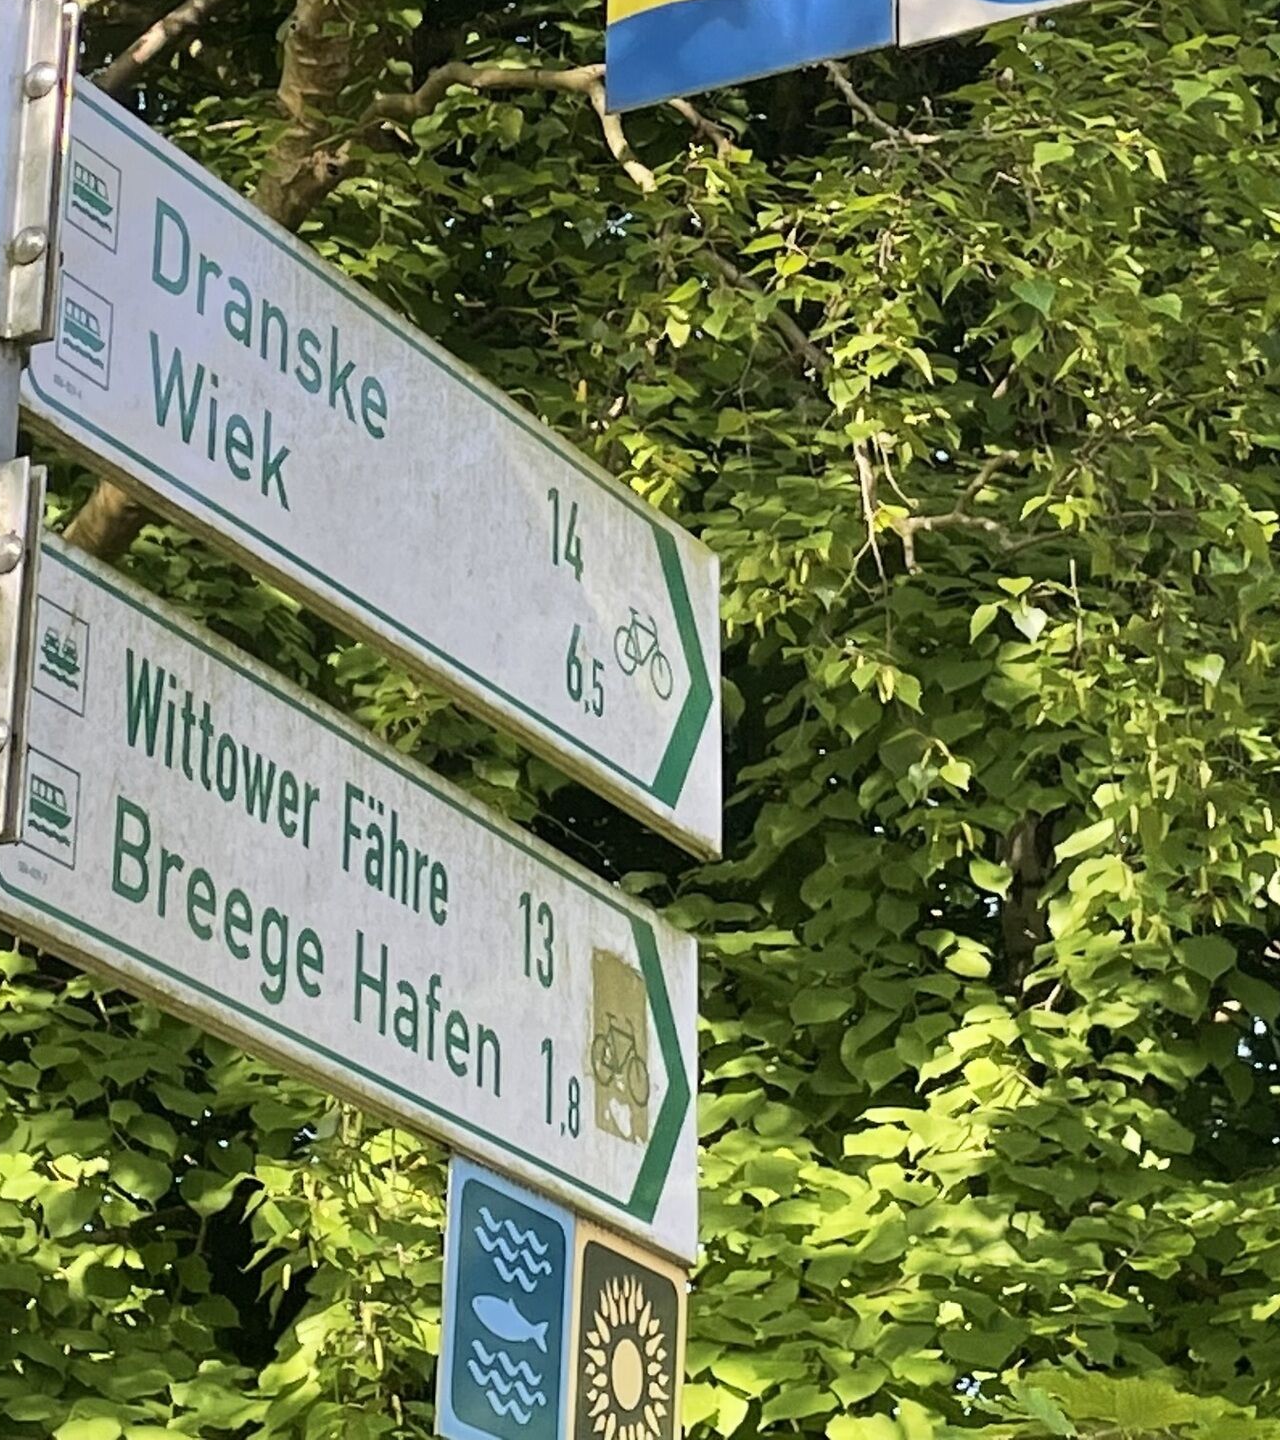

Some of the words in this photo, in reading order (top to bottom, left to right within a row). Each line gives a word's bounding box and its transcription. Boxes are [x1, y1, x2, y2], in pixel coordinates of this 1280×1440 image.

[149, 330, 291, 511] Wiek
[566, 623, 606, 718] 6,5
[150, 196, 389, 440] Dranske
[547, 486, 584, 582] 14
[111, 794, 326, 1006] Breege
[352, 930, 504, 1098] Hafen
[537, 1036, 583, 1140] 1,8
[124, 647, 321, 850] Wittower
[340, 782, 450, 927] Fähre
[519, 891, 556, 990] 13
